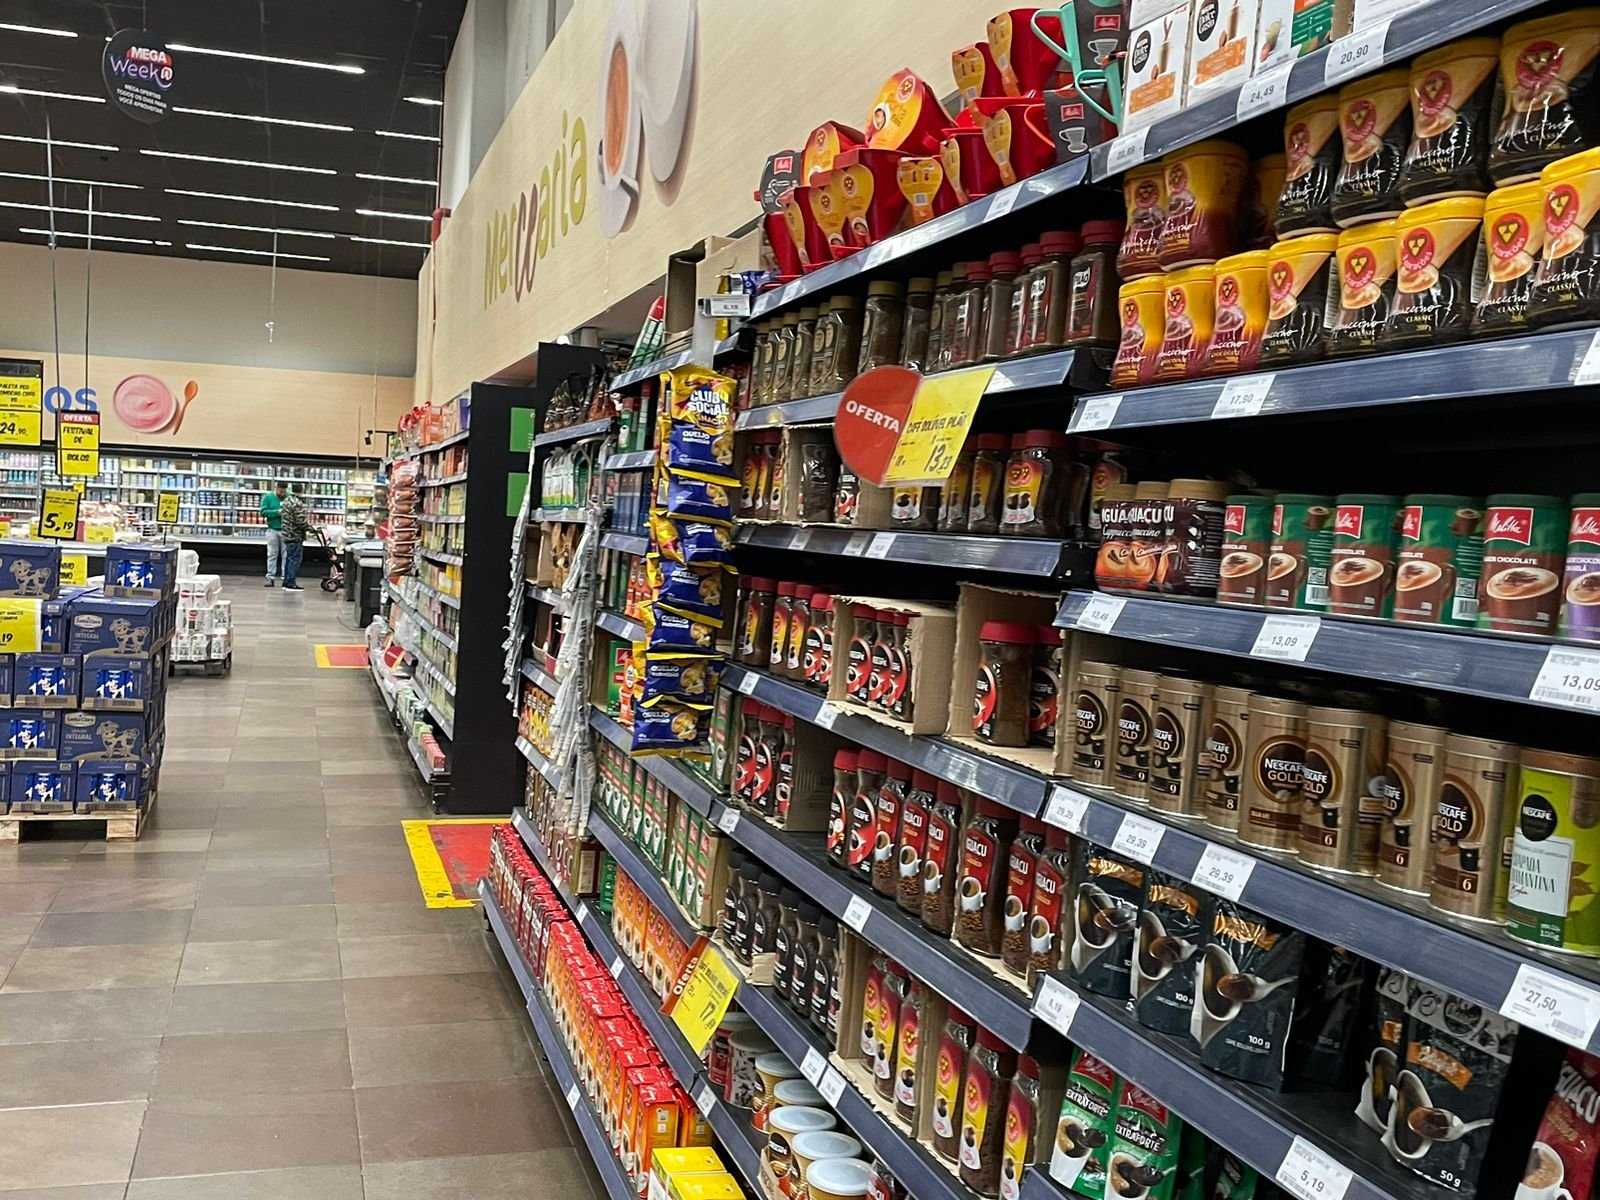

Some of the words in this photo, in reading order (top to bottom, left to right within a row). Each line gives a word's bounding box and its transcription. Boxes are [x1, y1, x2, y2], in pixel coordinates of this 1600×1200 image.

[131, 46, 167, 63] MEGA
[1340, 44, 1369, 64] 20,90
[1250, 84, 1275, 103] 24,49
[1547, 282, 1577, 293] CLASSIC
[1498, 304, 1527, 313] CLASSIC
[1405, 314, 1433, 323] CLASSIC
[690, 389, 721, 404] CLUB
[688, 401, 730, 416] SOCIAL
[63, 414, 93, 423] OFERTA
[846, 400, 900, 433] OFERTA
[63, 426, 94, 436] FESTIVAL
[682, 430, 711, 440] QUEIJO
[73, 436, 84, 444] DE
[66, 453, 90, 462] BOLOS
[44, 512, 74, 532] 5,19
[1490, 512, 1523, 534] Melitta
[1497, 556, 1538, 565] CHOCOLATE
[1271, 635, 1298, 648] 13,09
[1562, 674, 1600, 691] 13,09
[1094, 759, 1101, 769] 9
[1138, 771, 1146, 781] 9
[1267, 771, 1303, 784] GOLD
[1169, 784, 1177, 794] 9
[1226, 798, 1234, 809] 8
[1056, 806, 1074, 820] 29,39
[1126, 833, 1148, 849] 29,39
[1324, 834, 1333, 846] 6
[1396, 853, 1404, 865] 6
[1208, 867, 1235, 884] 29,39
[1462, 878, 1472, 891] 6
[673, 956, 699, 995] Oferta
[1175, 992, 1188, 1003] 100
[1526, 990, 1557, 1011] 27,50
[1248, 1034, 1263, 1047] 100
[1264, 1040, 1272, 1050] g
[1115, 1124, 1161, 1152] EXTRAFORTE
[1301, 1169, 1325, 1193] 5,19
[1440, 1168, 1453, 1182] 50
[1453, 1177, 1462, 1188] g
